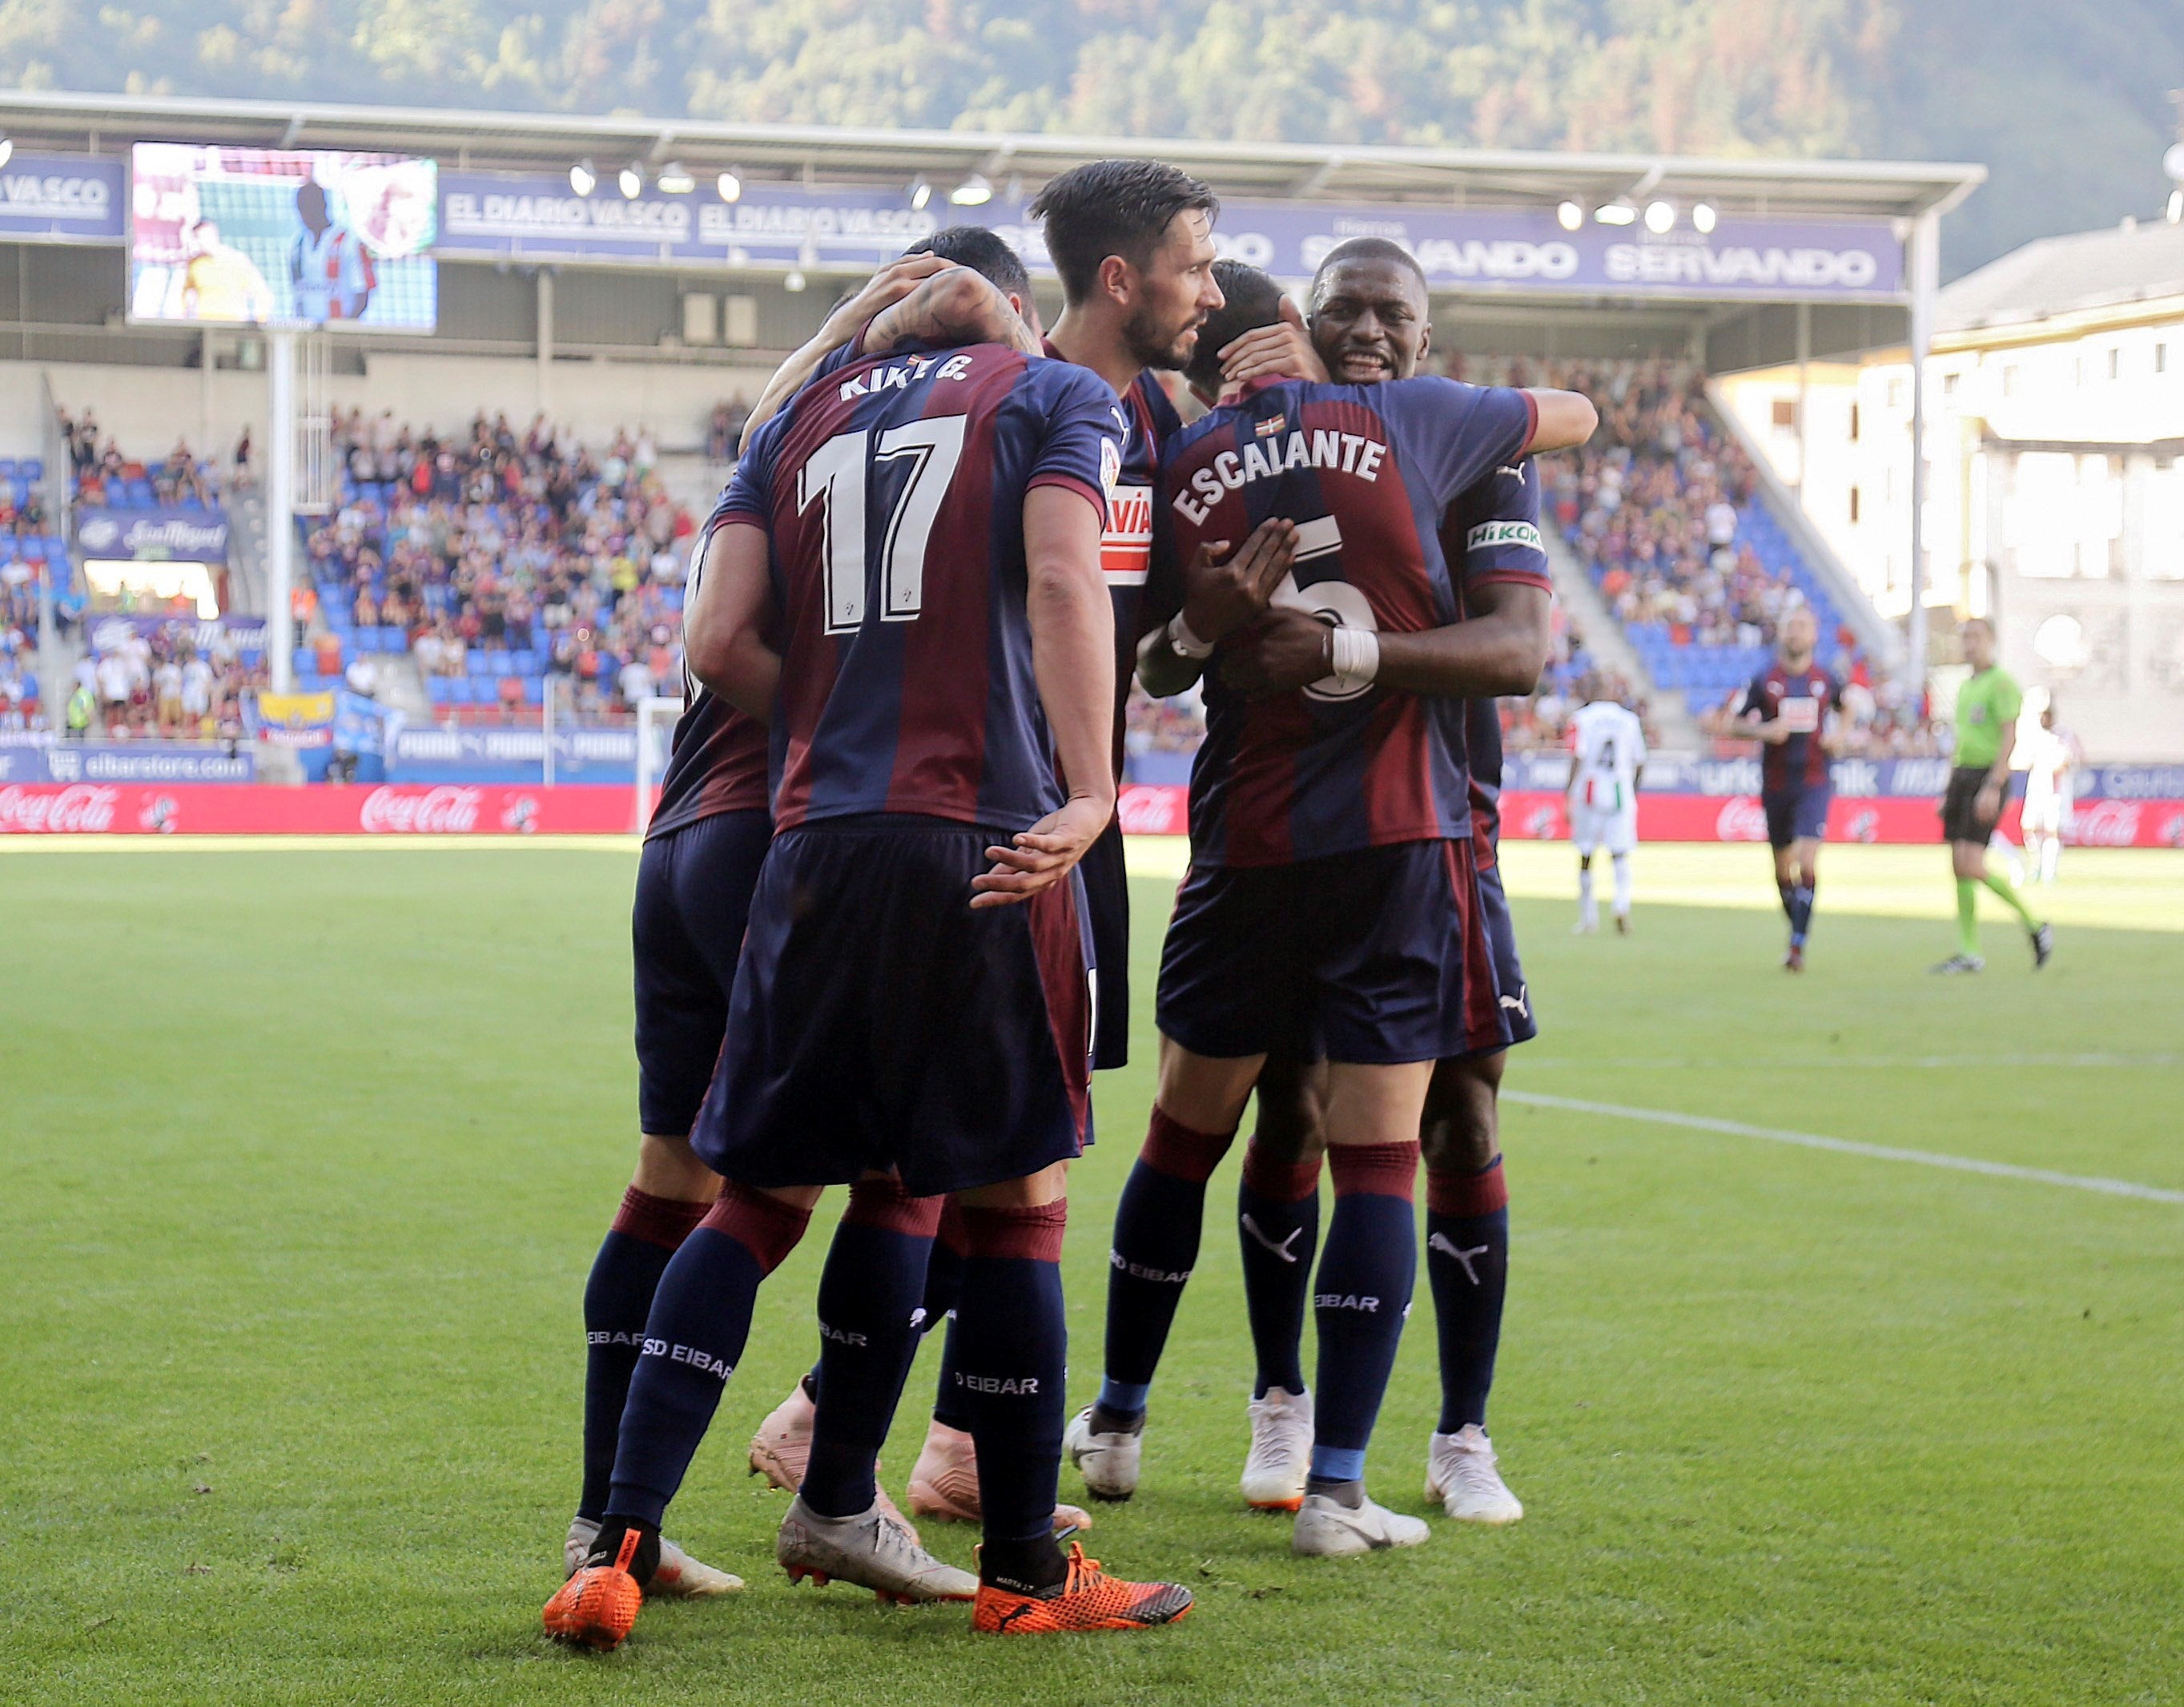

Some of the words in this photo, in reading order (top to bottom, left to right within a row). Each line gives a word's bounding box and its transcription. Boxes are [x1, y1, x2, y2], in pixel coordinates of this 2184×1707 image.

[2, 174, 110, 204] VASCO
[445, 192, 482, 219] EL
[484, 194, 588, 223] DIARIO
[589, 198, 691, 227] VASCO
[699, 203, 734, 229] EL
[735, 205, 837, 233] DIARIO
[838, 207, 938, 236] VASCO
[1605, 244, 1877, 287] SERVANDO
[935, 354, 973, 381] G.
[1173, 429, 1387, 526] ESCALANTE
[797, 413, 967, 636] 17
[1269, 514, 1380, 702] 5
[85, 752, 249, 779] eibarstore.com
[1597, 739, 1614, 771] 4
[360, 784, 481, 832] Coca-Cola
[642, 1338, 668, 1357] SD
[966, 1375, 1039, 1395] EIBAR
